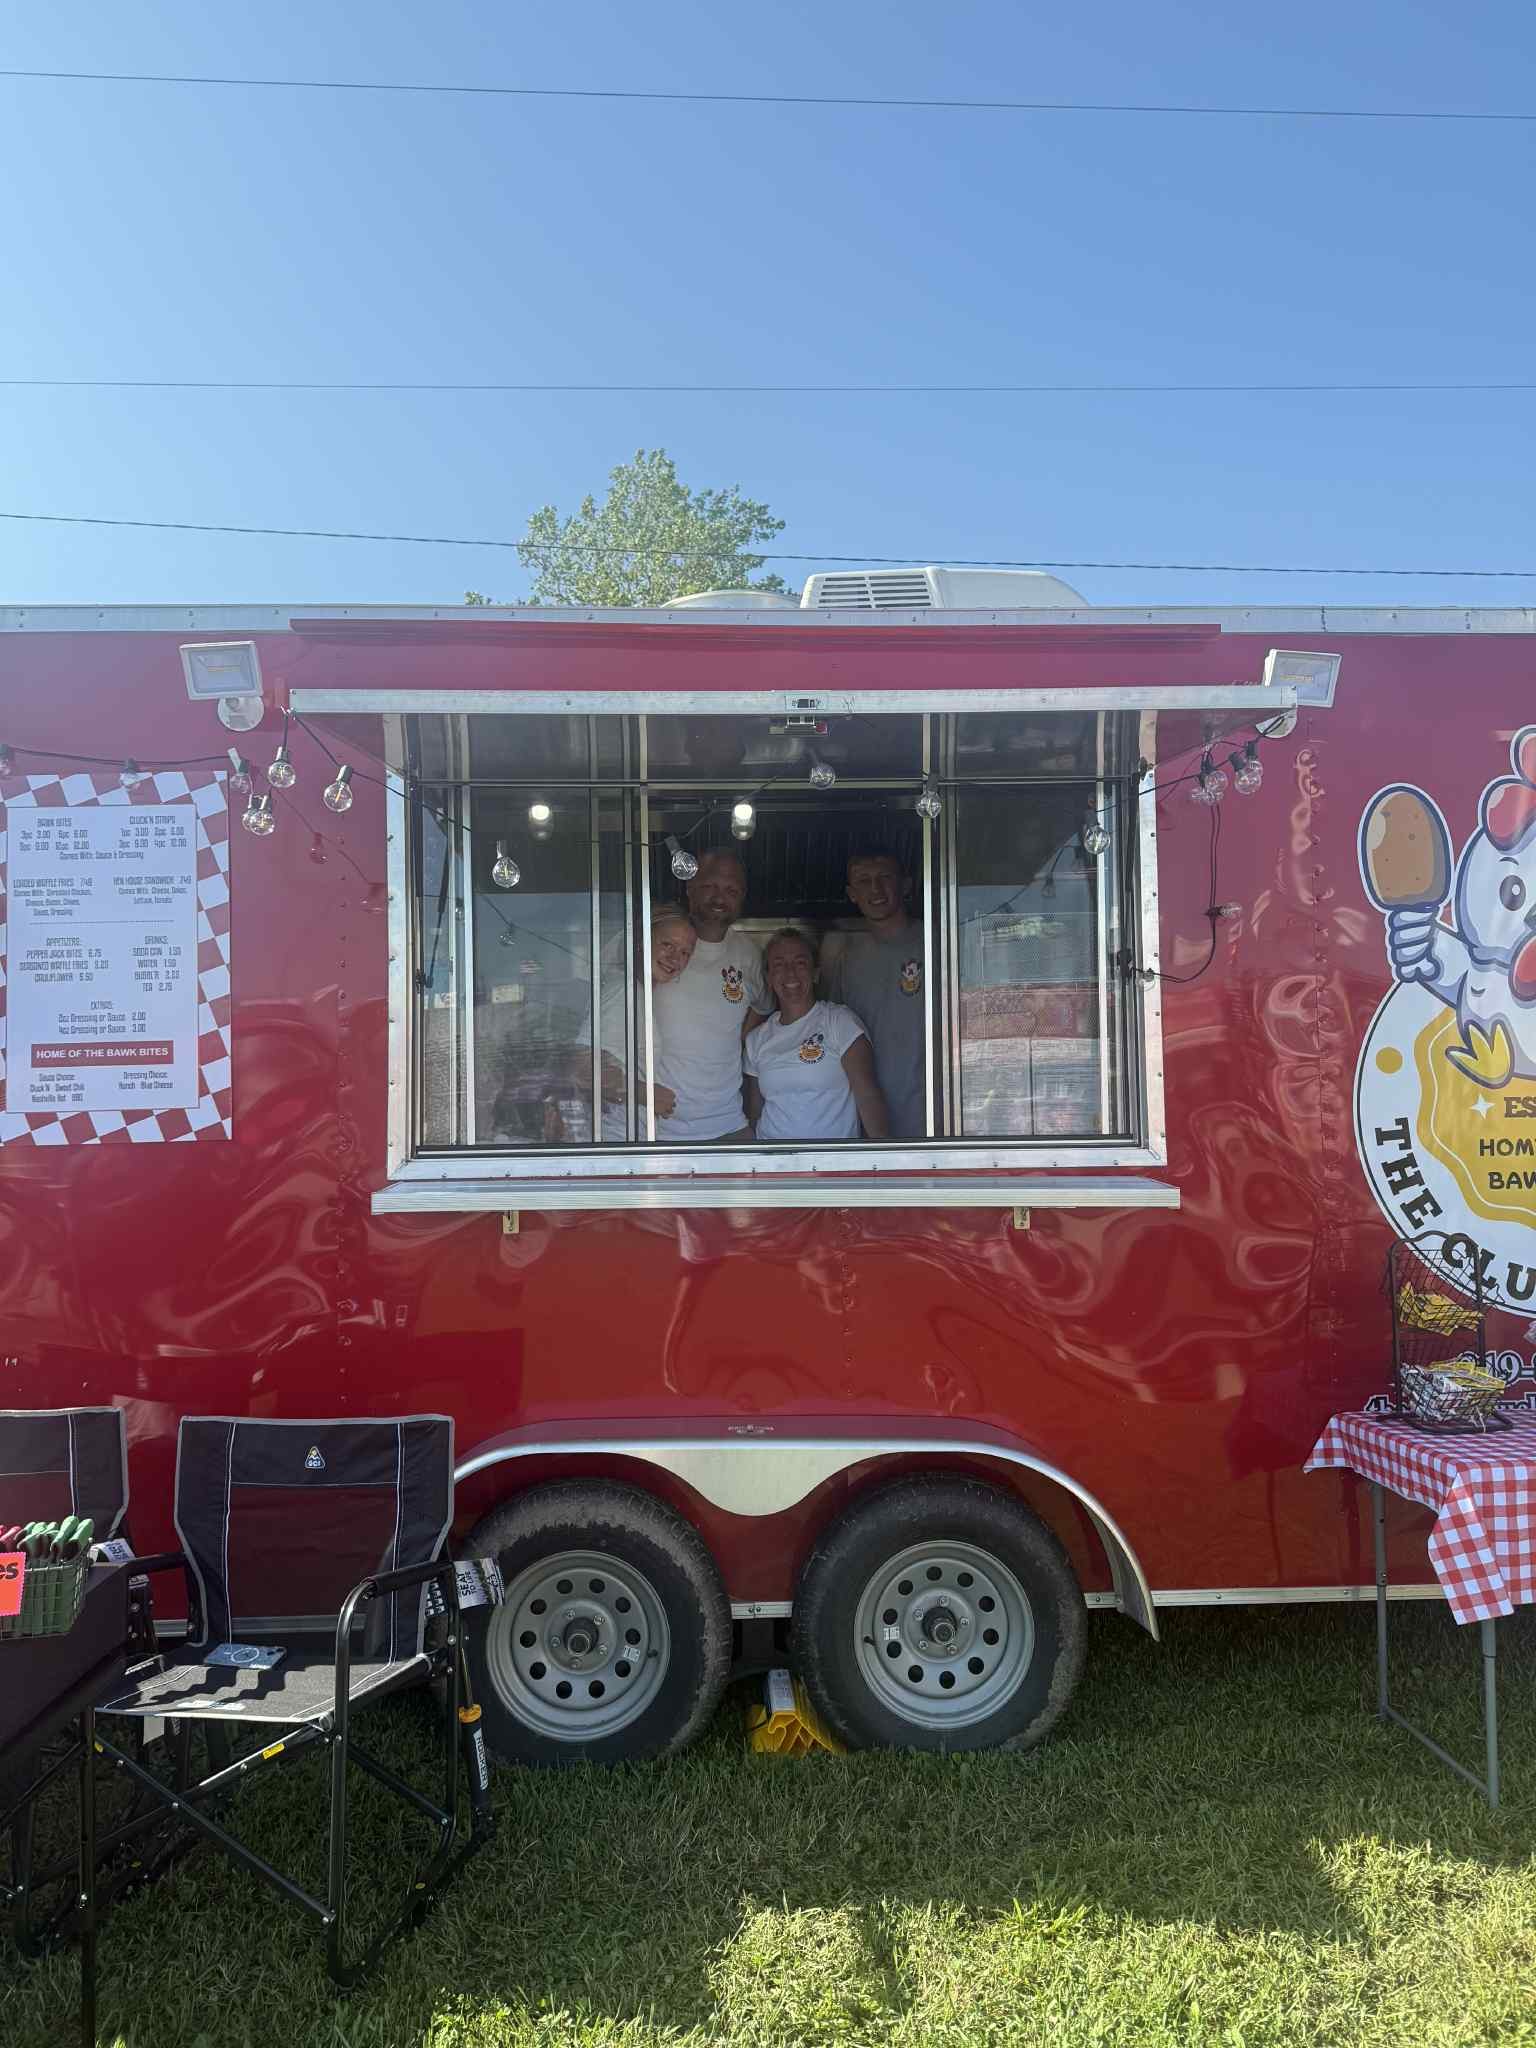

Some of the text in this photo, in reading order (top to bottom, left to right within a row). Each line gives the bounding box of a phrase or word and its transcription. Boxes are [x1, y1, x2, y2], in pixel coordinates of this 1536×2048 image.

[36, 1047, 168, 1060] HOME OF THE BAWK BITES
[1479, 1138, 1536, 1157] HOM
[1374, 1116, 1443, 1231] THE
[1456, 1349, 1536, 1388] 19-
[457, 1573, 471, 1597] SEAT
